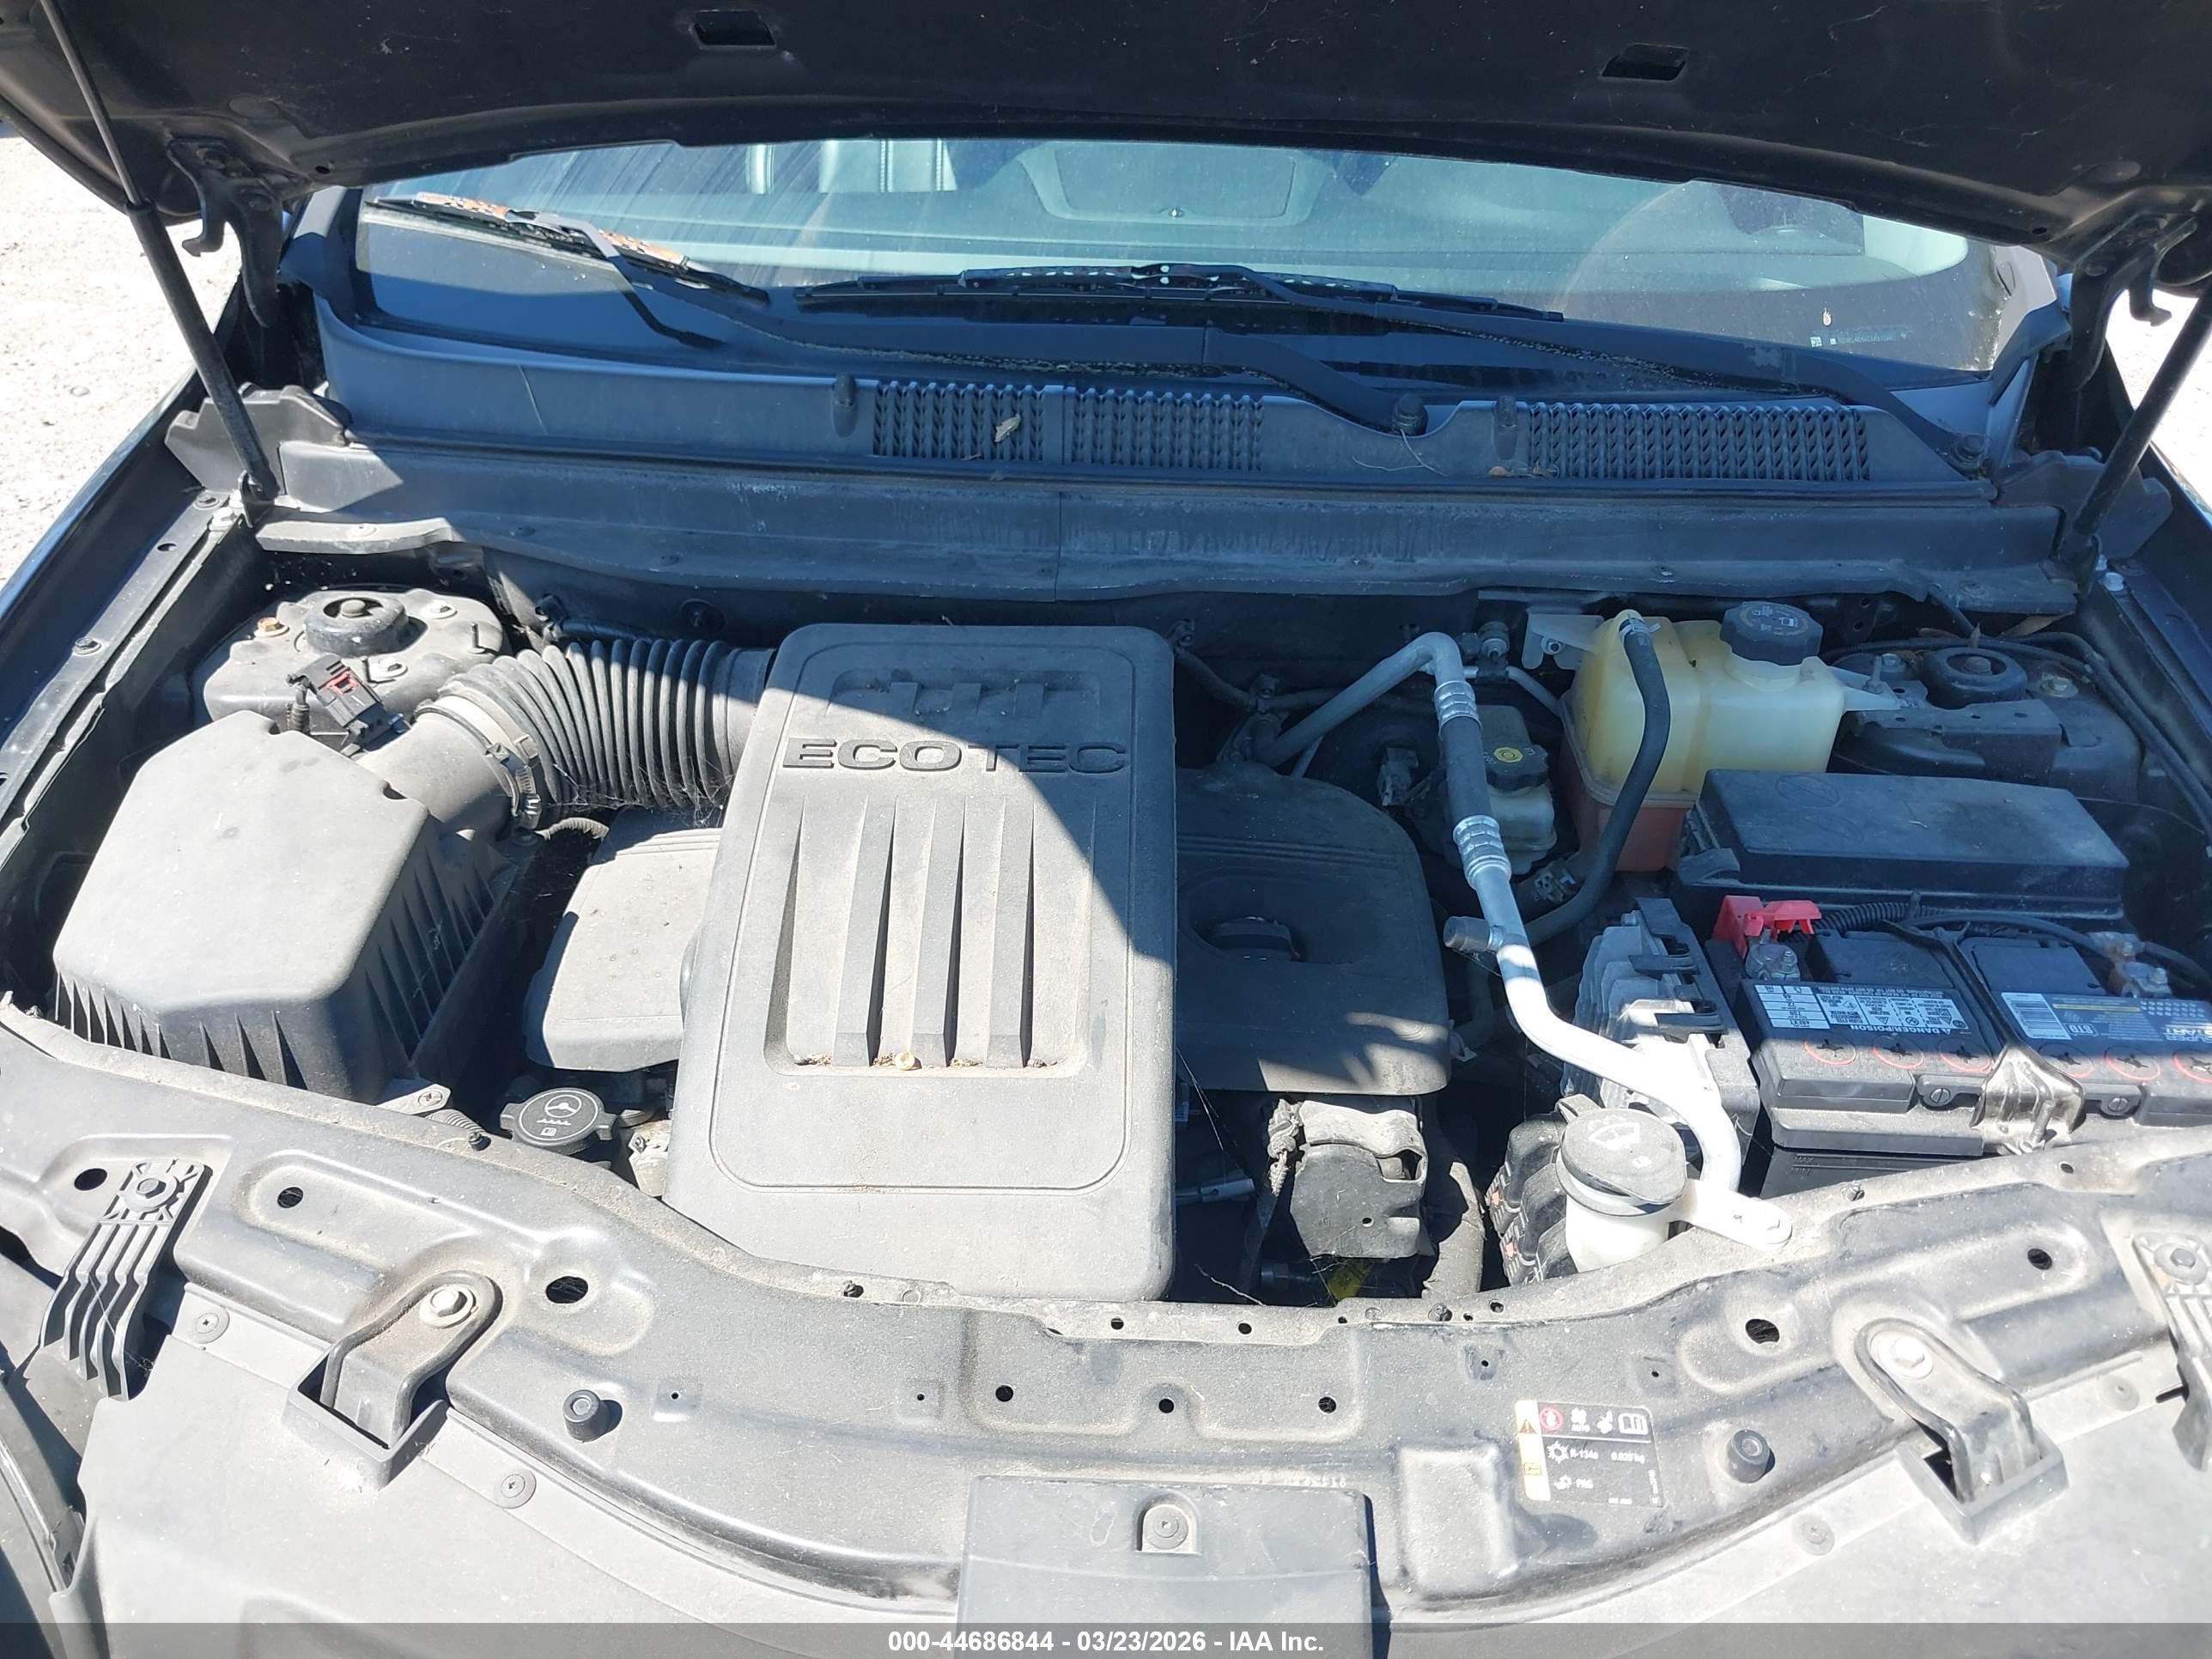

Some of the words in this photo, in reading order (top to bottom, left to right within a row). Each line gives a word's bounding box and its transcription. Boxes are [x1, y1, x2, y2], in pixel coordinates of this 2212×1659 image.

[782, 738, 1127, 775] ECOTEC
[1850, 1024, 1941, 1035] DANGER/POISON
[2068, 1024, 2092, 1035] STD
[1570, 1448, 1599, 1460] R-134a
